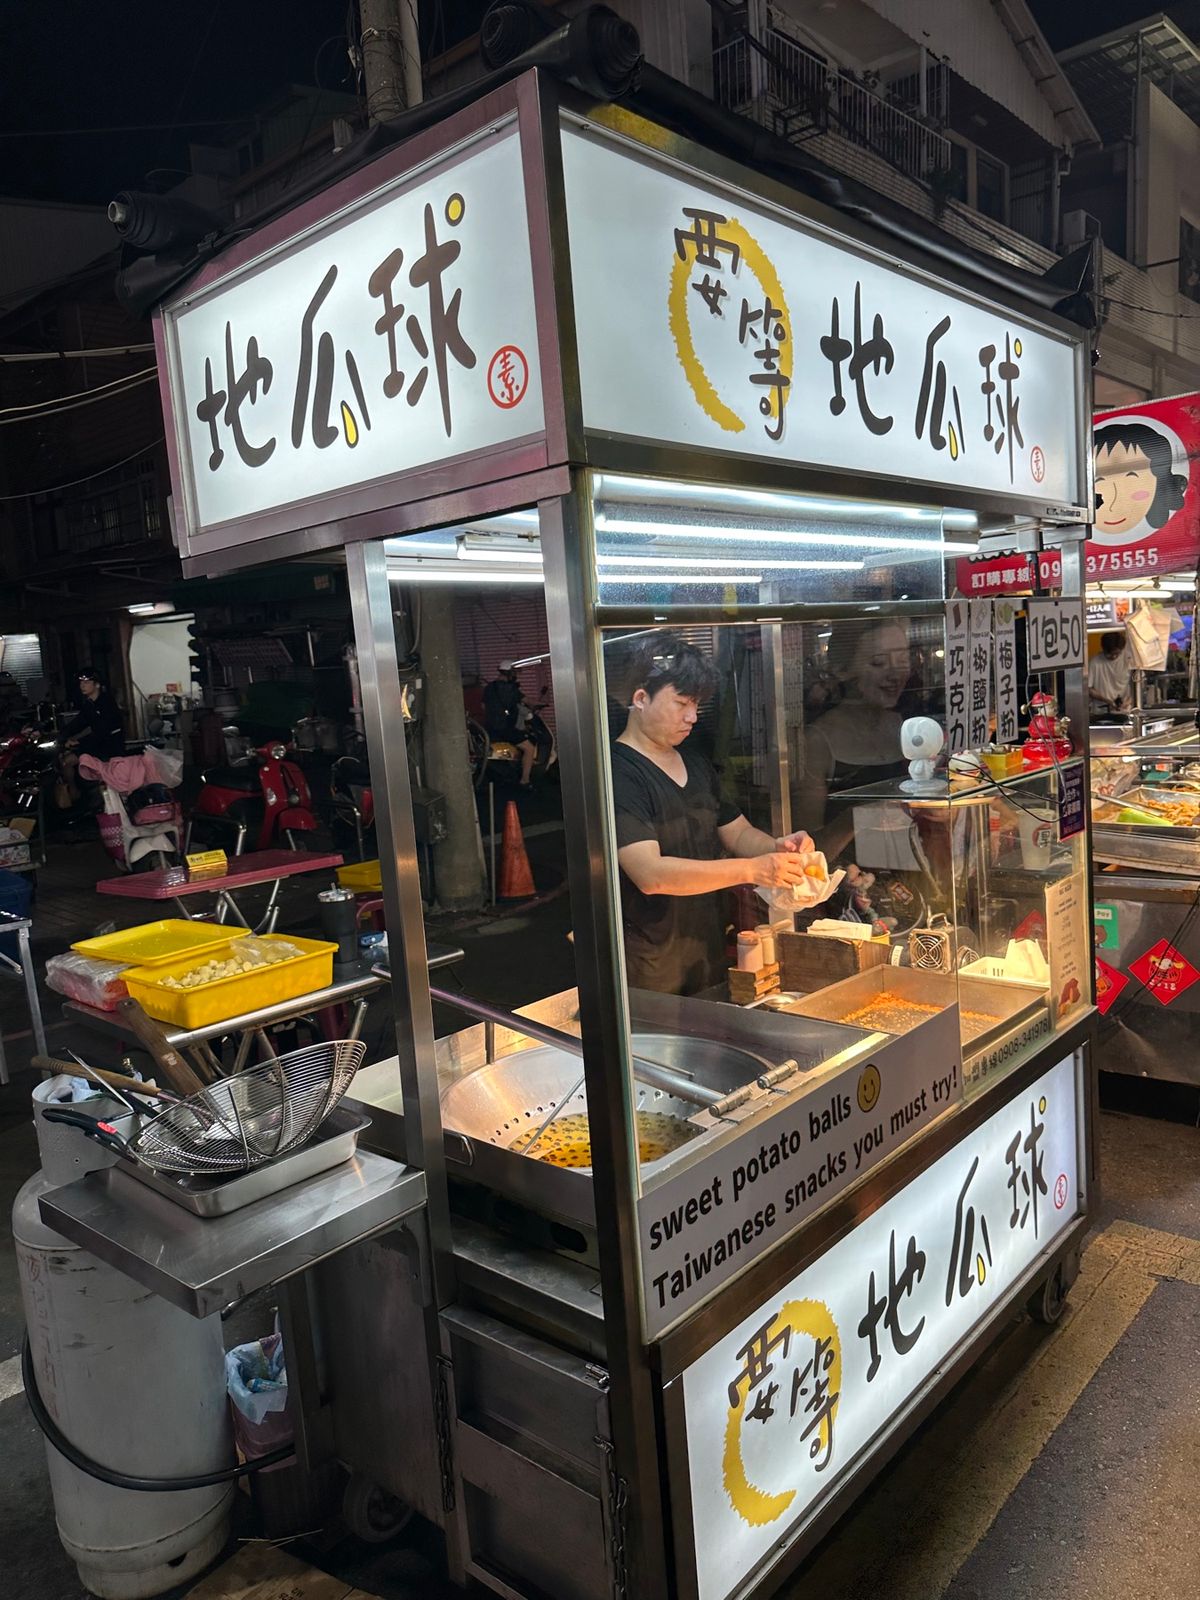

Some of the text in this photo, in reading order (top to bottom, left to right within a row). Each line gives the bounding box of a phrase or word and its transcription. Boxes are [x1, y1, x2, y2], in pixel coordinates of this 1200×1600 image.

[197, 193, 477, 471] 地瓜球
[494, 348, 524, 406] 素
[820, 281, 1024, 485] 地瓜球
[949, 646, 965, 750] 巧克力
[972, 643, 988, 744] 椒鹽粉
[999, 640, 1015, 737] 梅子粉
[1031, 610, 1081, 660] 1包50
[649, 1093, 852, 1250] sweet potato balls
[652, 1065, 958, 1308] Taiwanese snacks you must try!
[858, 1095, 1049, 1383] 地瓜球
